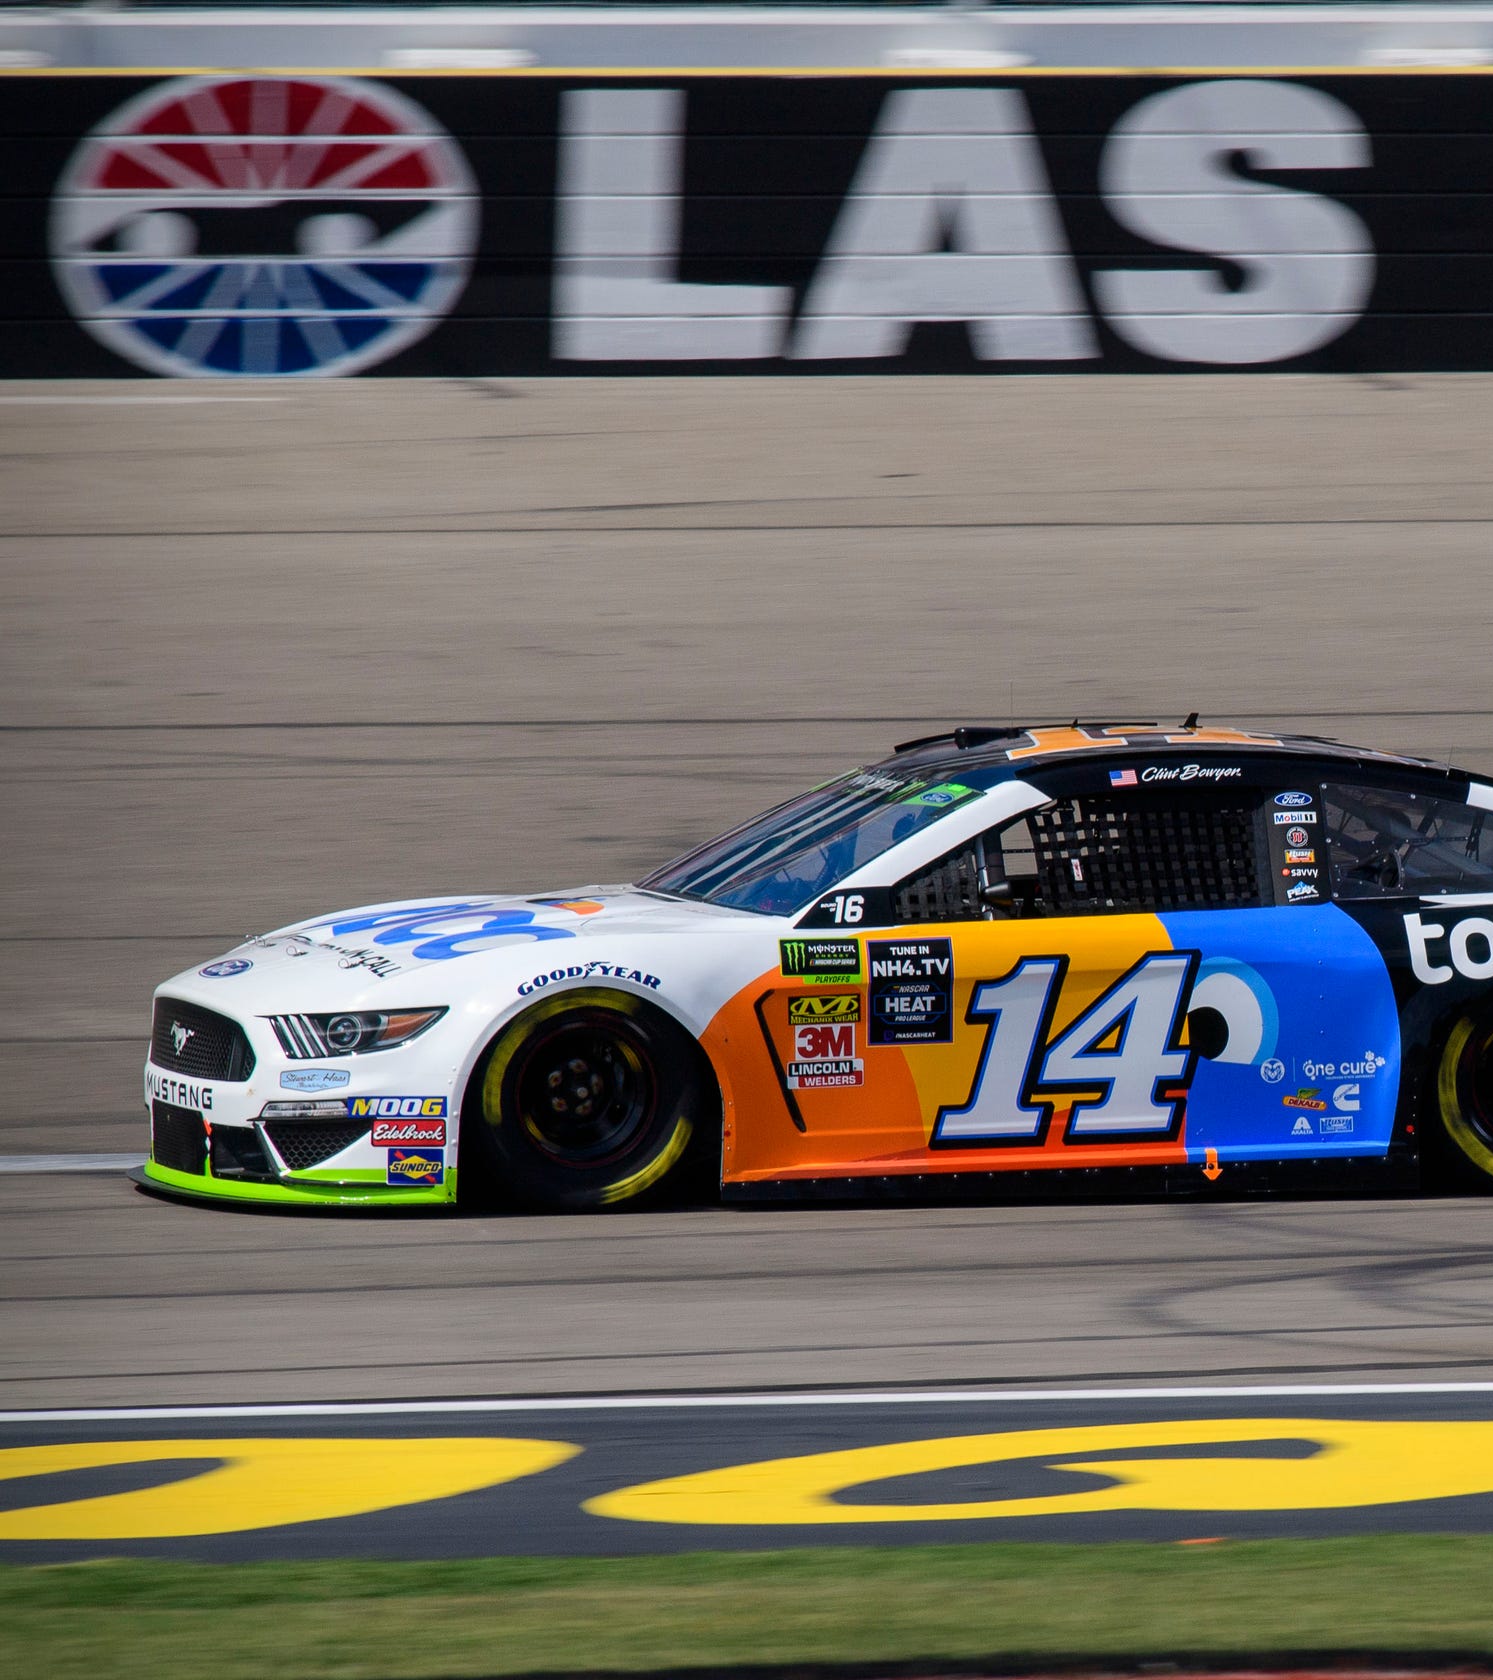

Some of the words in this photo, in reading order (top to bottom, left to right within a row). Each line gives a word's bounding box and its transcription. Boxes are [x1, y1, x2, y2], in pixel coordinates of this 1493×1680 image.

[552, 80, 1374, 364] LAS
[1141, 766, 1180, 782] Clint
[1275, 814, 1302, 823] Mobil
[1291, 868, 1319, 879] savvy
[1287, 885, 1319, 899] PEAK
[834, 895, 865, 924] 16
[808, 944, 856, 954] MONSTER
[889, 946, 917, 956] TUNE
[918, 945, 930, 955] IN
[872, 958, 949, 978] NH4.TV
[517, 961, 662, 996] GOODYEAR
[815, 975, 851, 983] PLAYOFFS
[899, 985, 930, 993] NASCAR
[885, 996, 936, 1013] HEAT
[790, 1015, 833, 1025] MECHANIX
[834, 1013, 859, 1022] WEAR
[797, 1026, 853, 1058] 3M
[928, 949, 1202, 1150] 14
[791, 1062, 850, 1076] LINCOLN
[1304, 1063, 1336, 1077] one
[1340, 1062, 1376, 1075] cure
[804, 1075, 856, 1087] WELDERS
[146, 1071, 213, 1110] MUSTANG
[351, 1098, 444, 1116] MOOG
[1288, 1098, 1321, 1109] DEKALB
[373, 1123, 444, 1140] Edelbrock
[391, 1161, 440, 1173] SUNOCO
